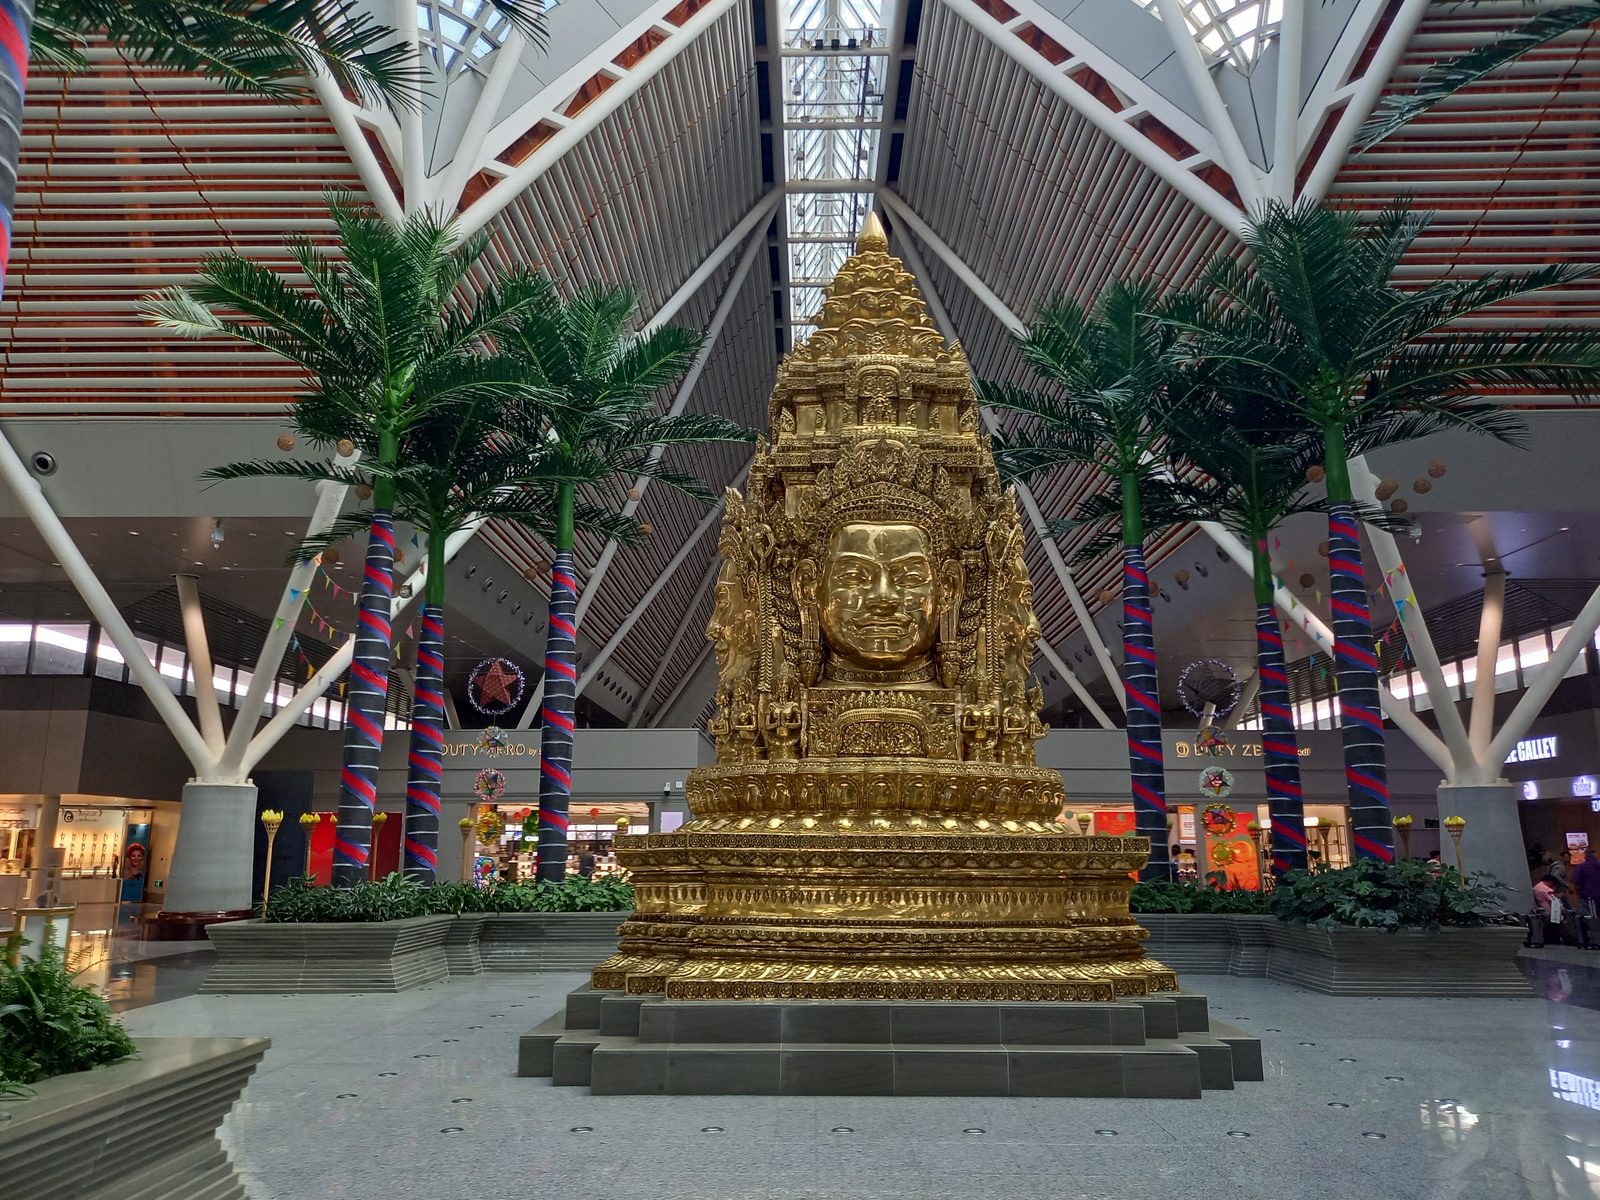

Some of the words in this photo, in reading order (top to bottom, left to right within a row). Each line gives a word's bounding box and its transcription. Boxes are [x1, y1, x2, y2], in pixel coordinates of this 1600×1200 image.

[528, 747, 537, 757] by
[1194, 743, 1237, 757] DTY
[1517, 736, 1557, 762] GALLEY
